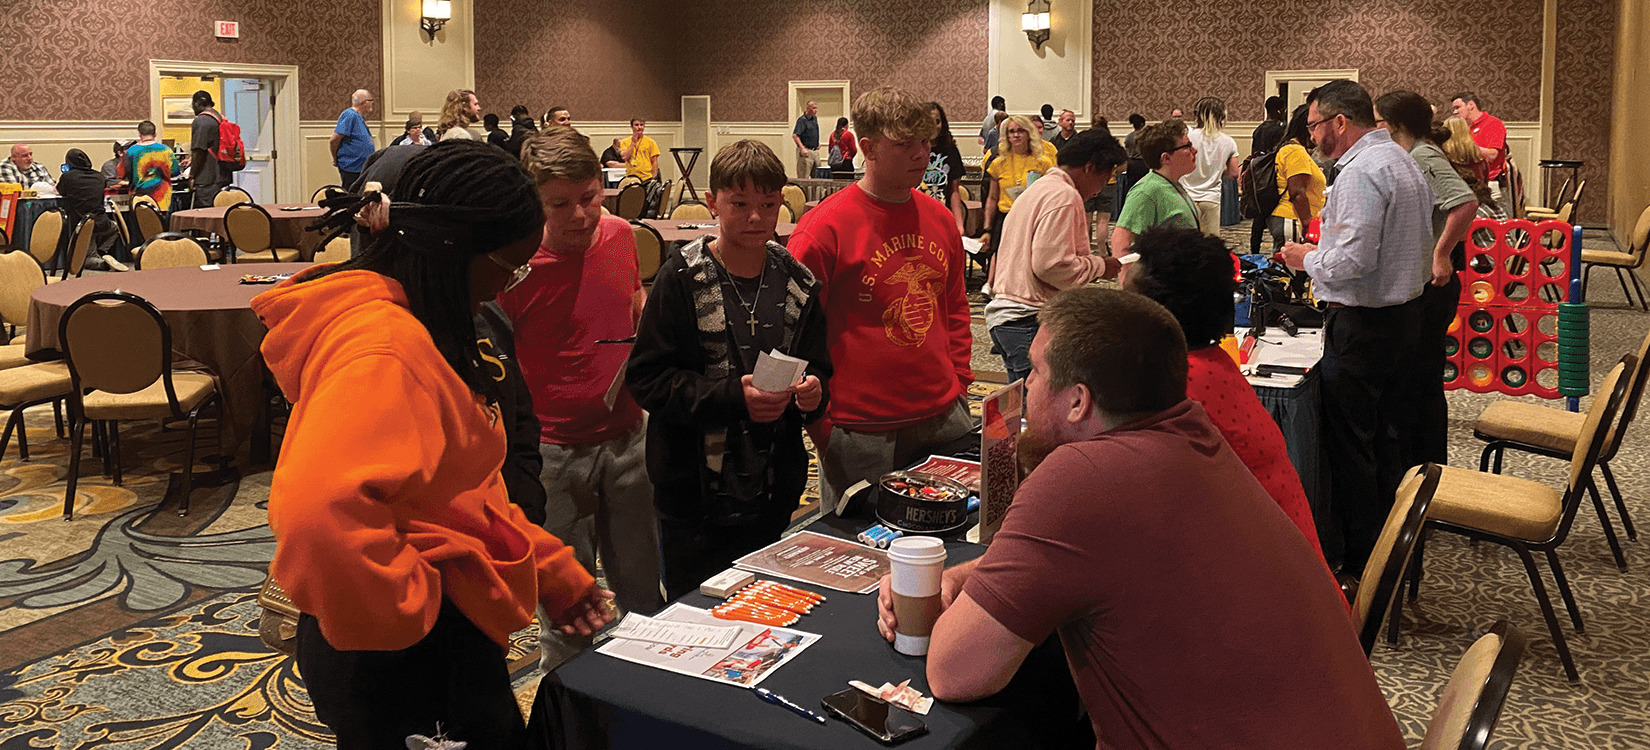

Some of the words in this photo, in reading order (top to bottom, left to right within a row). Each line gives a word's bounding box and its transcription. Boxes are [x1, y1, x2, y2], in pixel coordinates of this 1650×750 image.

[220, 22, 236, 37] EXIT
[859, 272, 877, 303] U.S.
[870, 233, 925, 269] MARINE
[905, 506, 957, 523] HERSHEY'S
[836, 557, 878, 578] SWEET
